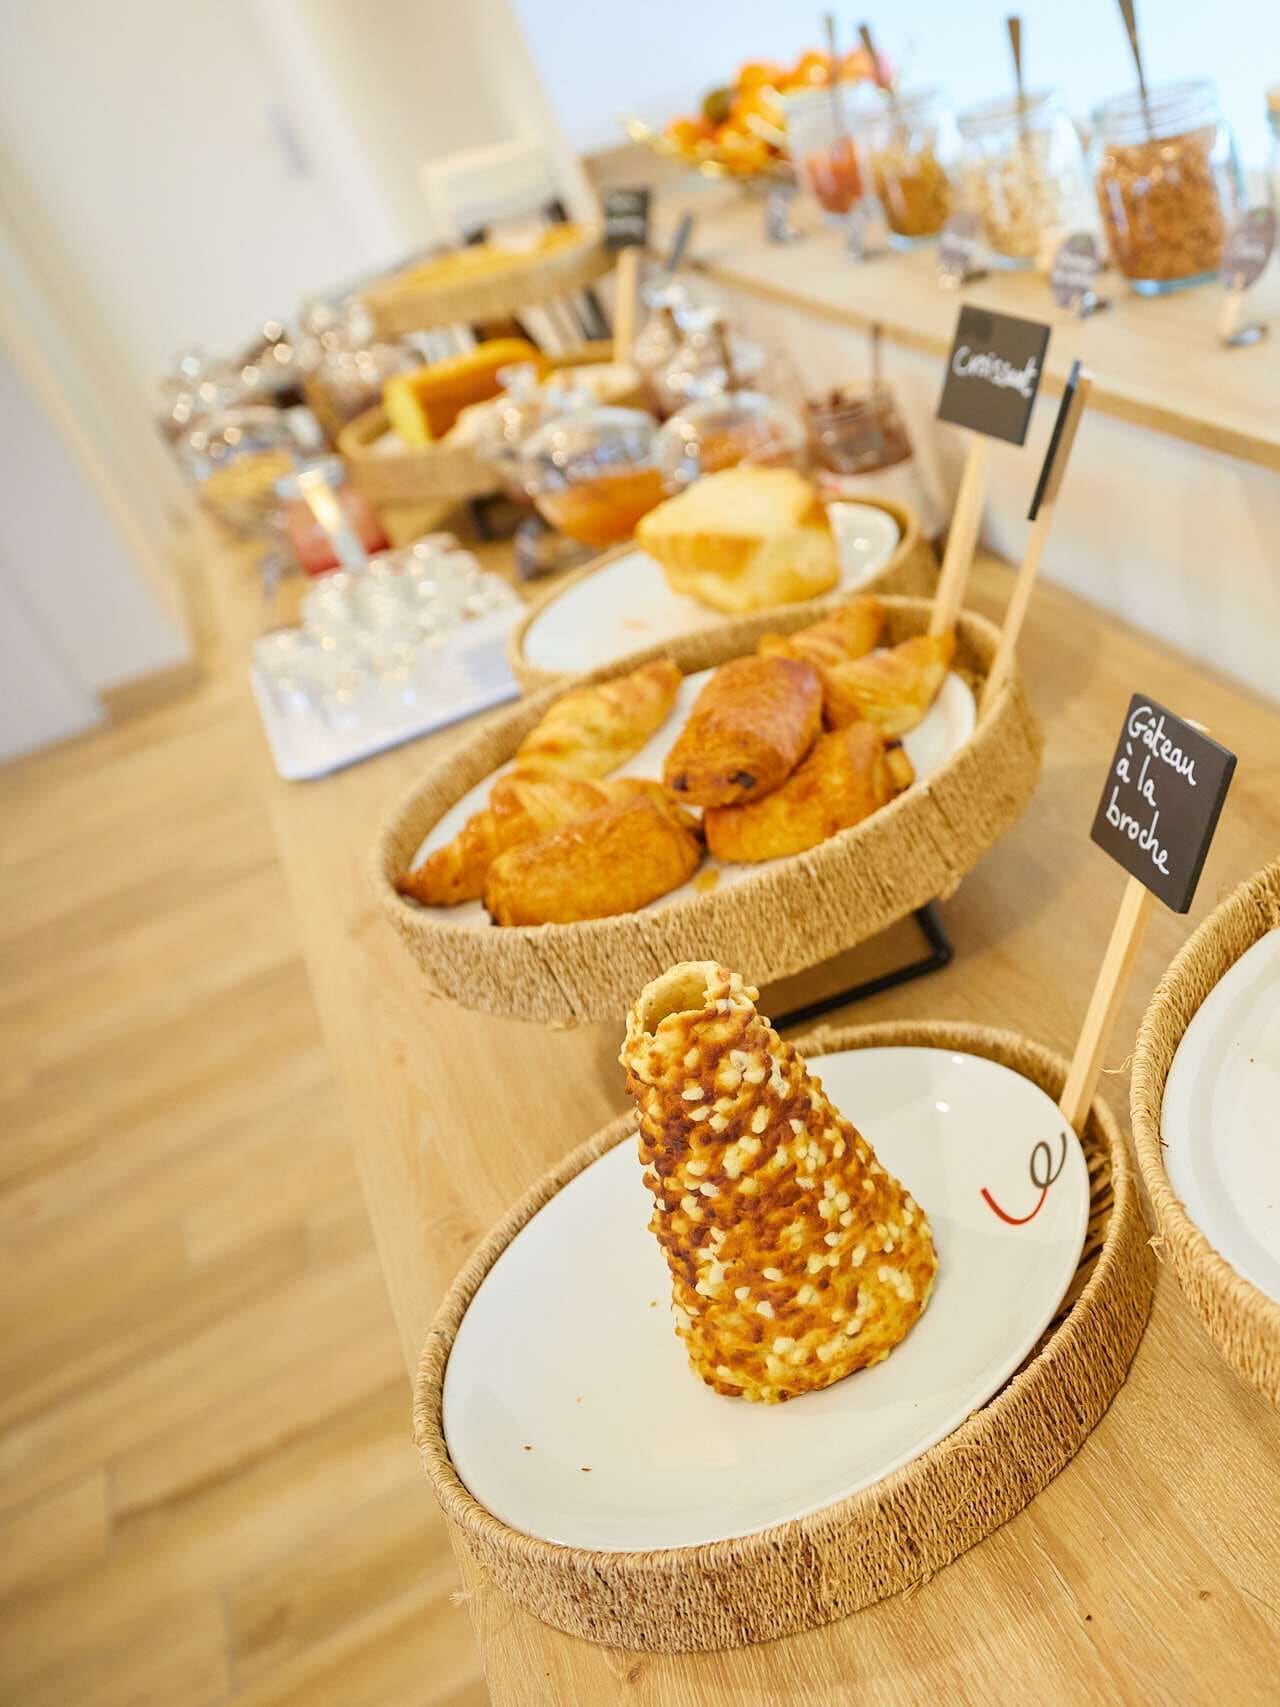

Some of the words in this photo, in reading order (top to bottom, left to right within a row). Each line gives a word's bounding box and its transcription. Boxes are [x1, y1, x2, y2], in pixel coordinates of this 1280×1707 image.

[1116, 741, 1132, 784] à
[1137, 755, 1157, 807] la
[1127, 706, 1197, 786] Gâteau
[1106, 785, 1170, 875] broche
